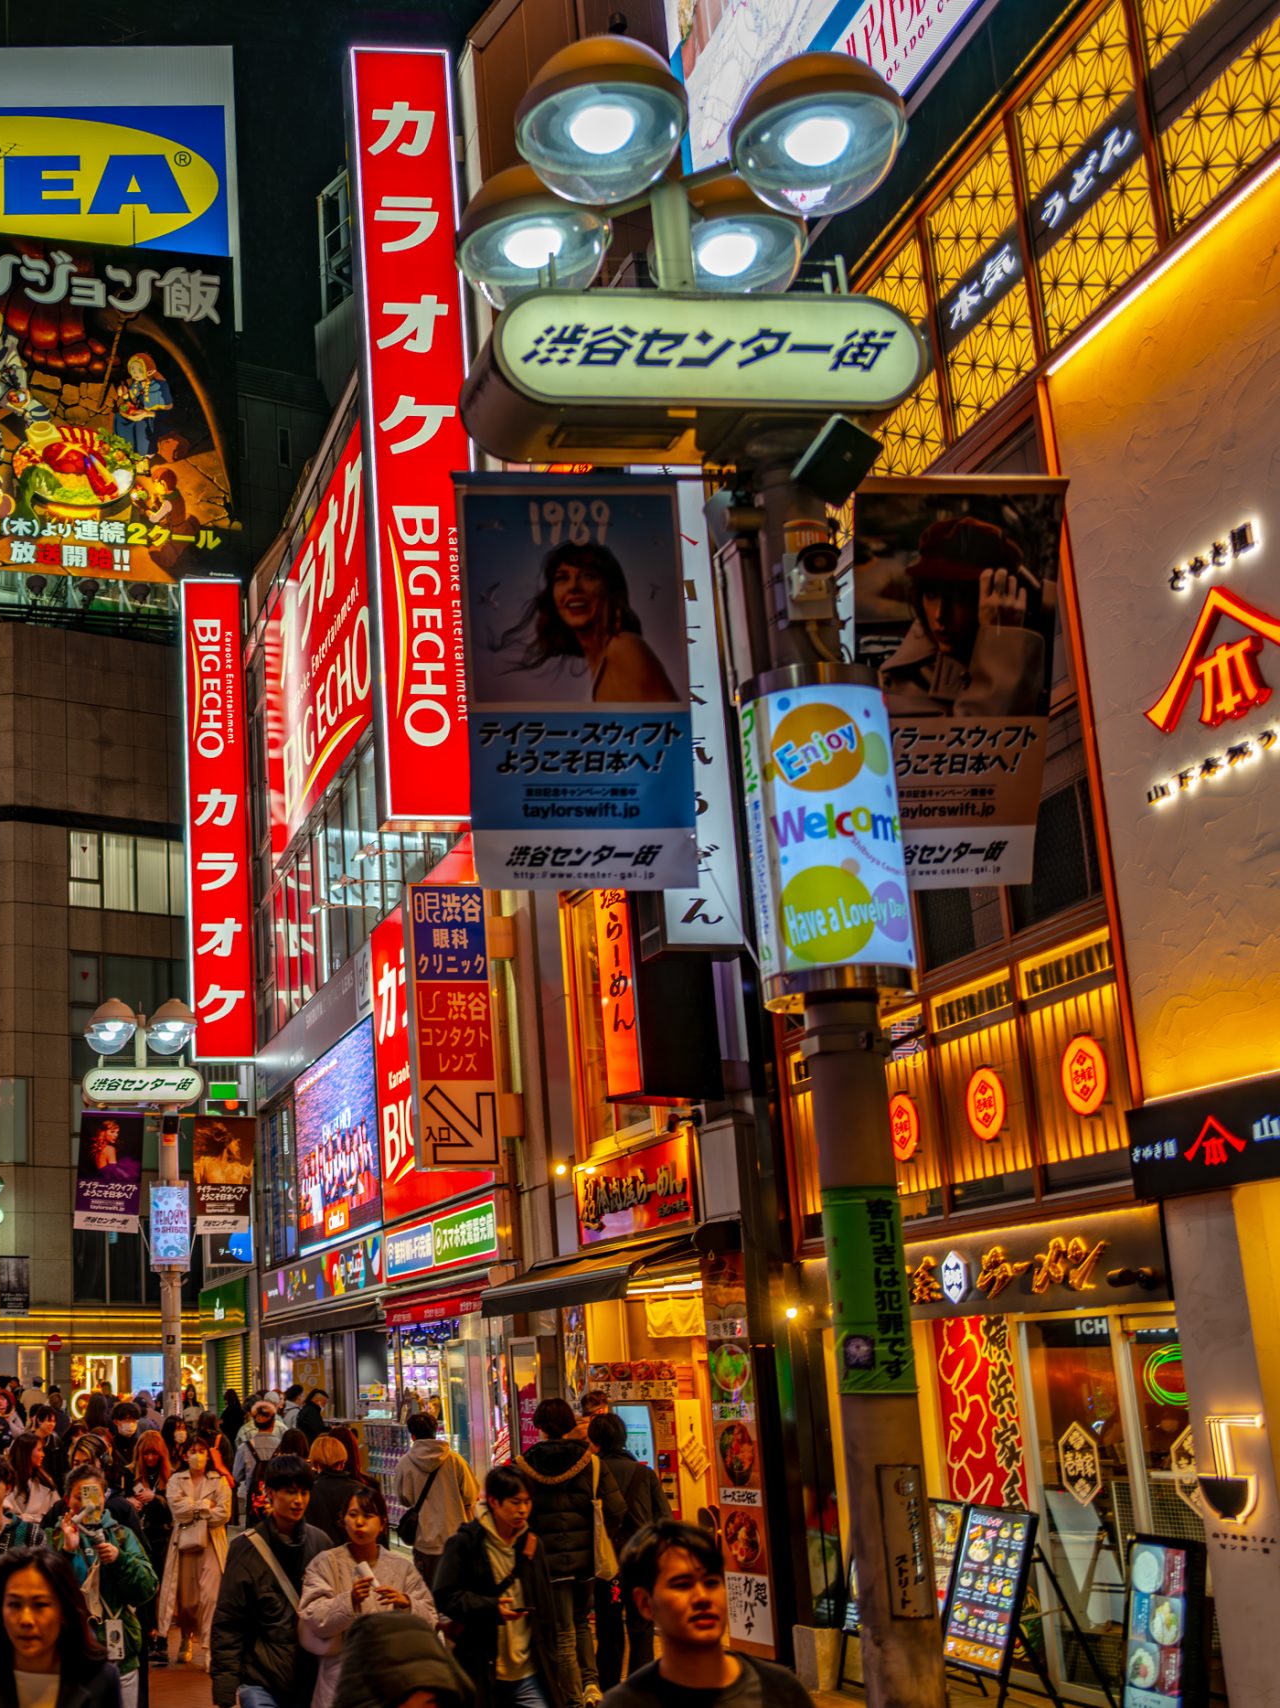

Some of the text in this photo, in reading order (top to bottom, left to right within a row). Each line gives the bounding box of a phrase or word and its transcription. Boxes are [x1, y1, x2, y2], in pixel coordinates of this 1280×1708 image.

[904, 15, 933, 58] IDOL
[368, 101, 456, 454] カラオケ
[522, 324, 896, 371] 渋谷センター街
[528, 500, 612, 548] 1989
[10, 540, 131, 572] 放送開始!!
[280, 451, 363, 690] カラオケ
[448, 527, 468, 722] Karaoke Entertainment
[223, 631, 235, 744] Karaoke Entertainment
[404, 608, 451, 746] ECHO
[197, 676, 224, 758] ECHO
[478, 721, 683, 747] テイラー・スウィフト
[495, 749, 666, 774] ようこそ日本へ!
[774, 722, 857, 783] Enjoy
[523, 802, 640, 819] taylorswift.jp
[505, 843, 663, 867] 渋谷センター街
[196, 789, 245, 1024] カラオケ
[441, 893, 481, 923] 渋谷
[784, 905, 826, 947] Have
[828, 905, 840, 932] a
[841, 897, 888, 927] Lovely
[432, 928, 469, 950] 眼科
[418, 953, 485, 974] クリニック
[447, 992, 487, 1021] 渋谷
[421, 1028, 489, 1047] コンタクト
[439, 1053, 477, 1073] レンズ
[91, 1076, 195, 1092] 渋谷センター街
[425, 1126, 451, 1142] 入口
[78, 1181, 138, 1191] テイラー・スウィフト
[197, 1185, 248, 1194] テイラー・スウィフト
[866, 1198, 907, 1381] 客引きは犯罪です
[895, 1554, 911, 1609] ストリート
